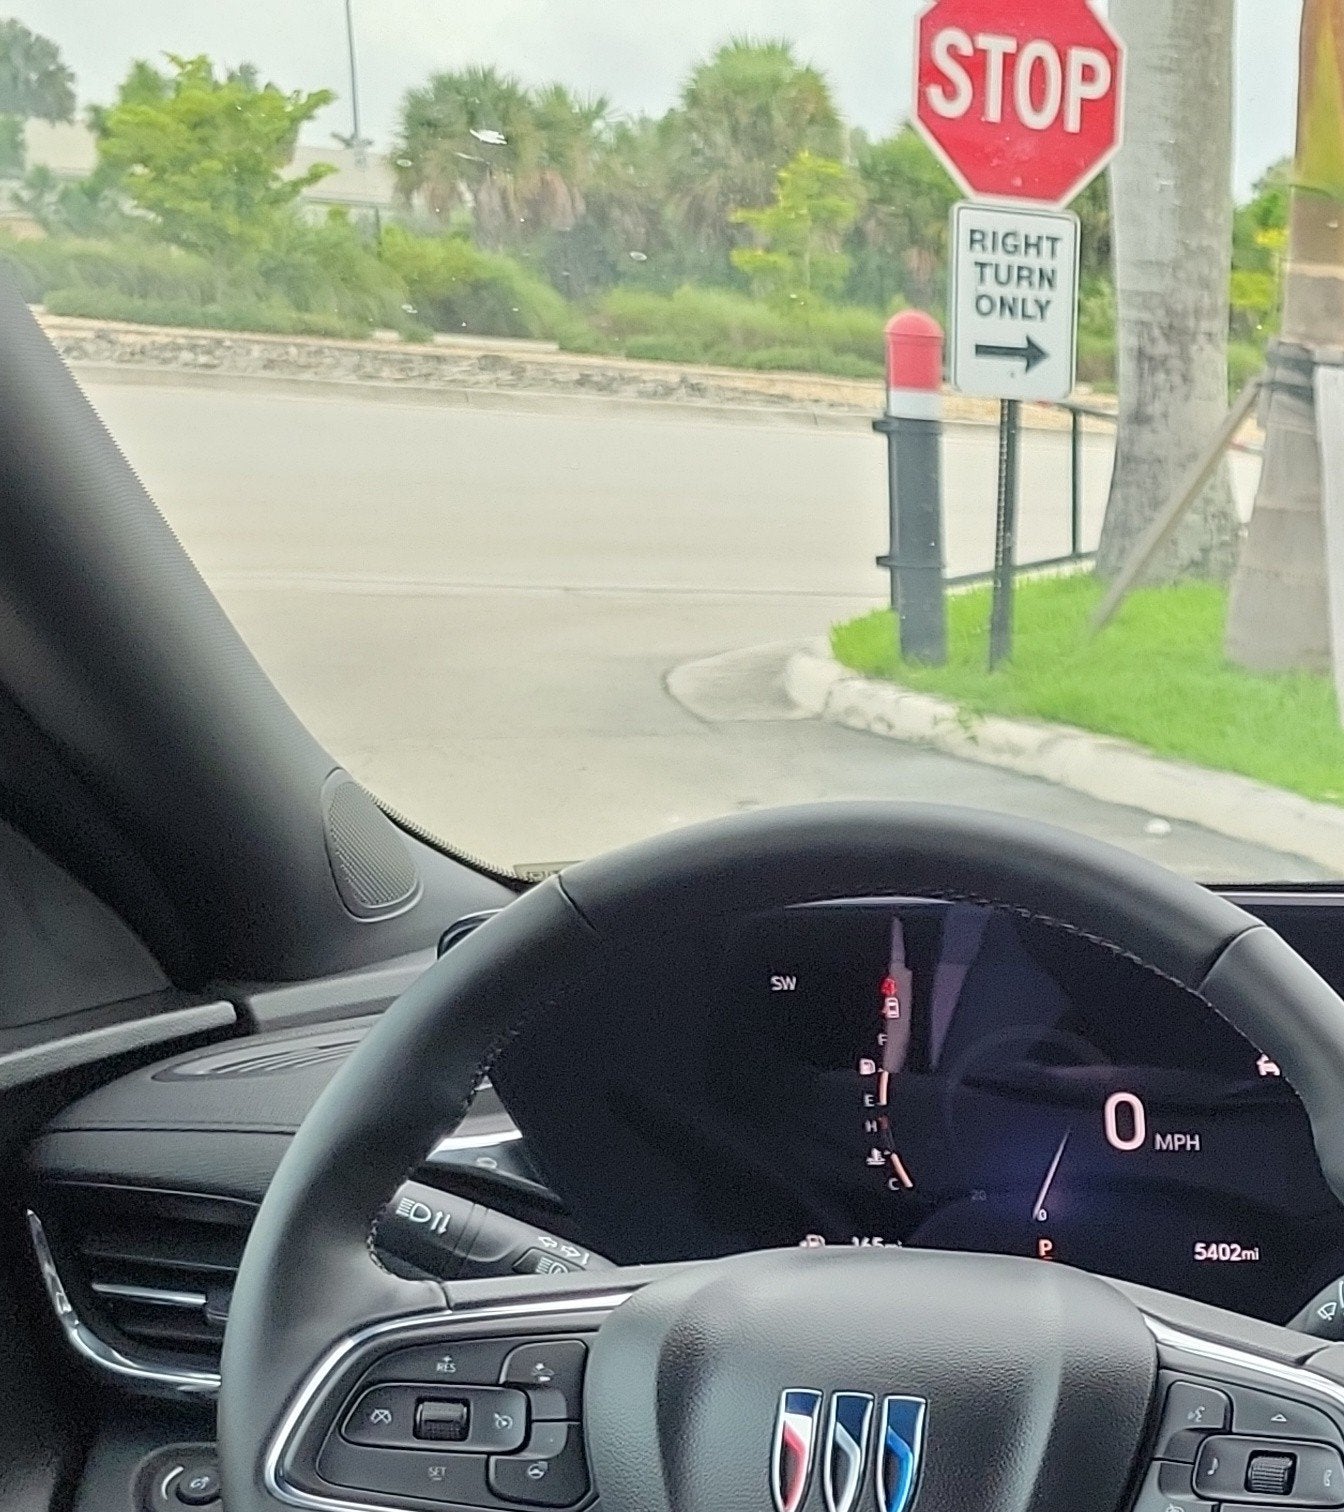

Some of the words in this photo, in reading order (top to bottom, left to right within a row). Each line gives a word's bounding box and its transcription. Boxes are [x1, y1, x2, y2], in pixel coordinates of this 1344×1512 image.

[926, 27, 1112, 133] STOP
[968, 228, 1062, 259] RIGHT
[974, 261, 1058, 291] TURN
[975, 293, 1052, 321] ONLY
[770, 975, 797, 992] SW
[877, 1032, 888, 1046] F
[864, 1093, 875, 1107] E
[864, 1119, 878, 1133] H
[1104, 1091, 1146, 1151] 0
[1154, 1133, 1200, 1151] MPH
[888, 1177, 900, 1191] C
[1039, 1239, 1053, 1257] P
[1194, 1242, 1260, 1261] 5402mi
[436, 1362, 457, 1373] RES
[428, 1465, 447, 1478] SET
